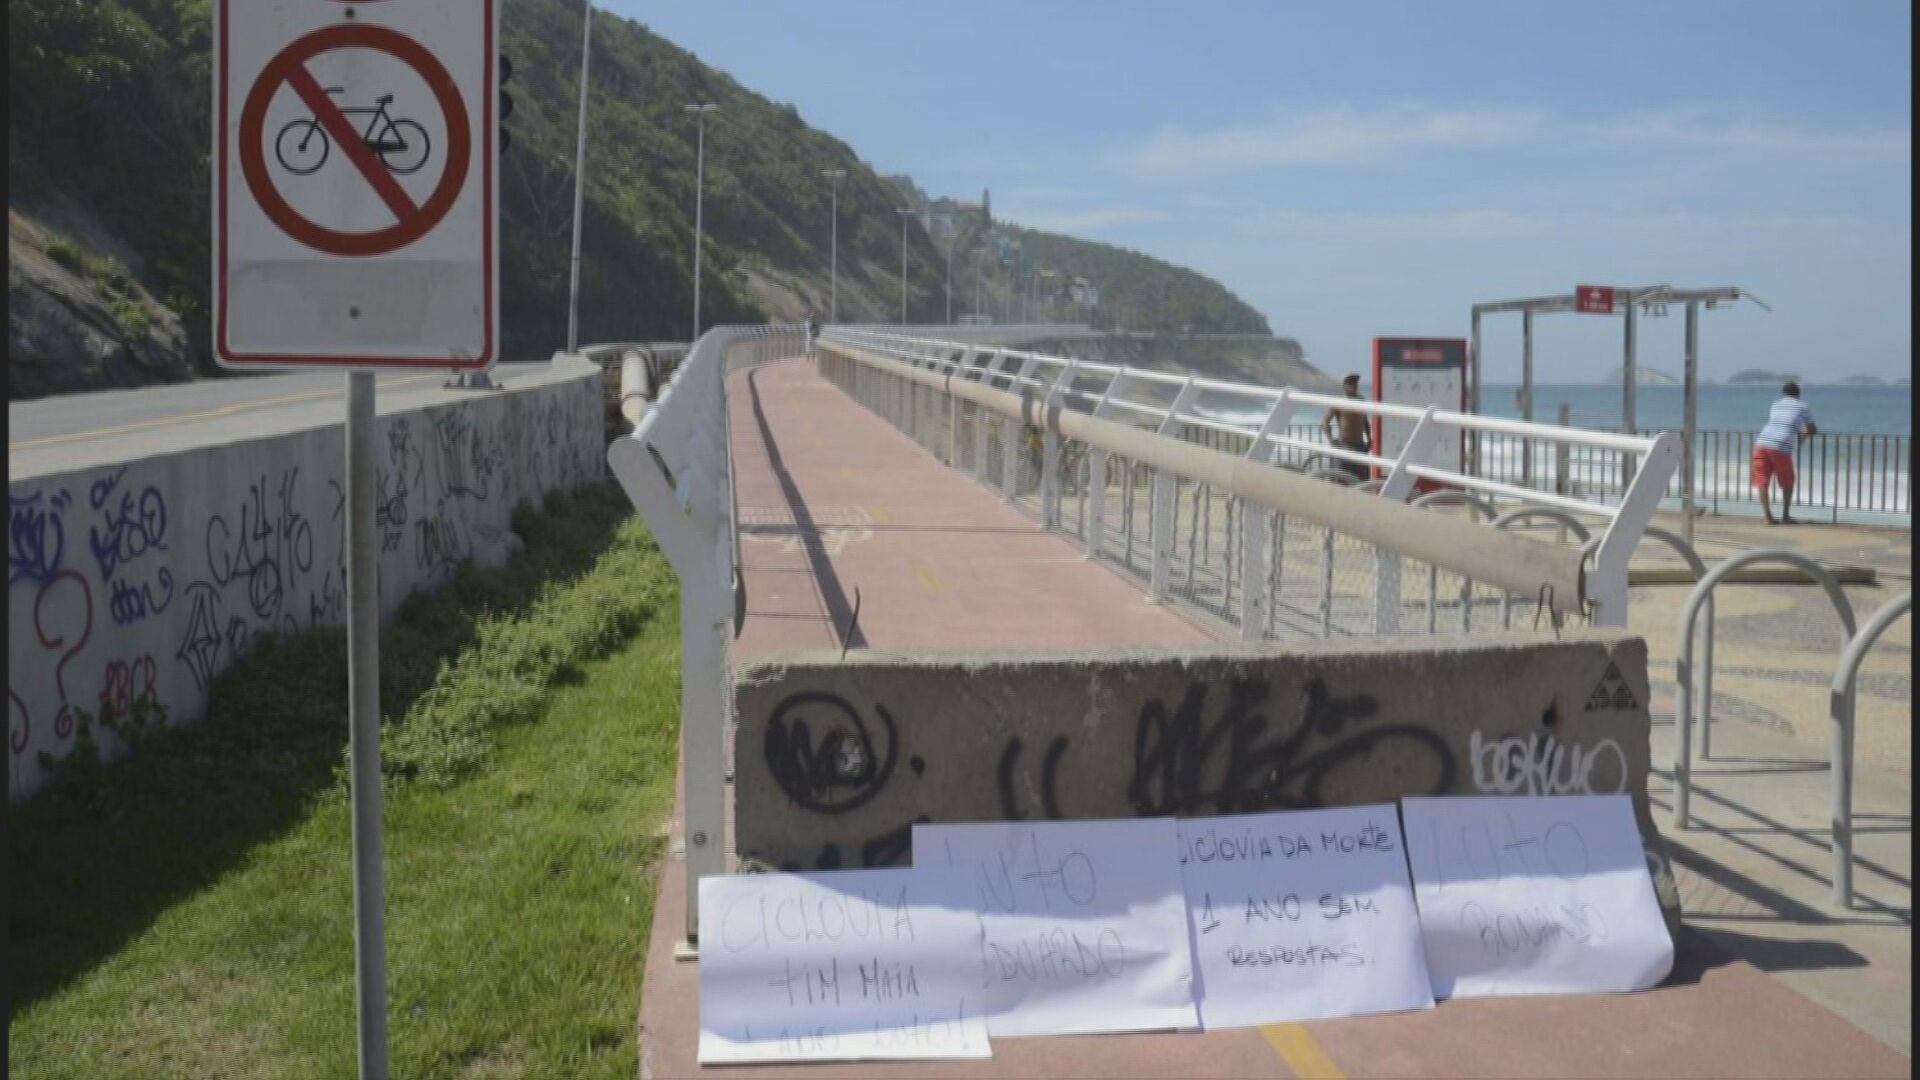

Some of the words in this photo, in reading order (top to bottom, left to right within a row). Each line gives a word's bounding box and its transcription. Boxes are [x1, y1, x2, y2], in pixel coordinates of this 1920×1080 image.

[1279, 834, 1312, 858] DA
[721, 884, 914, 953] CICLOVIA
[1246, 894, 1301, 924] ANO
[1318, 893, 1380, 919] SEM
[859, 955, 919, 1001] MAIA
[984, 926, 1125, 984] DUARDO
